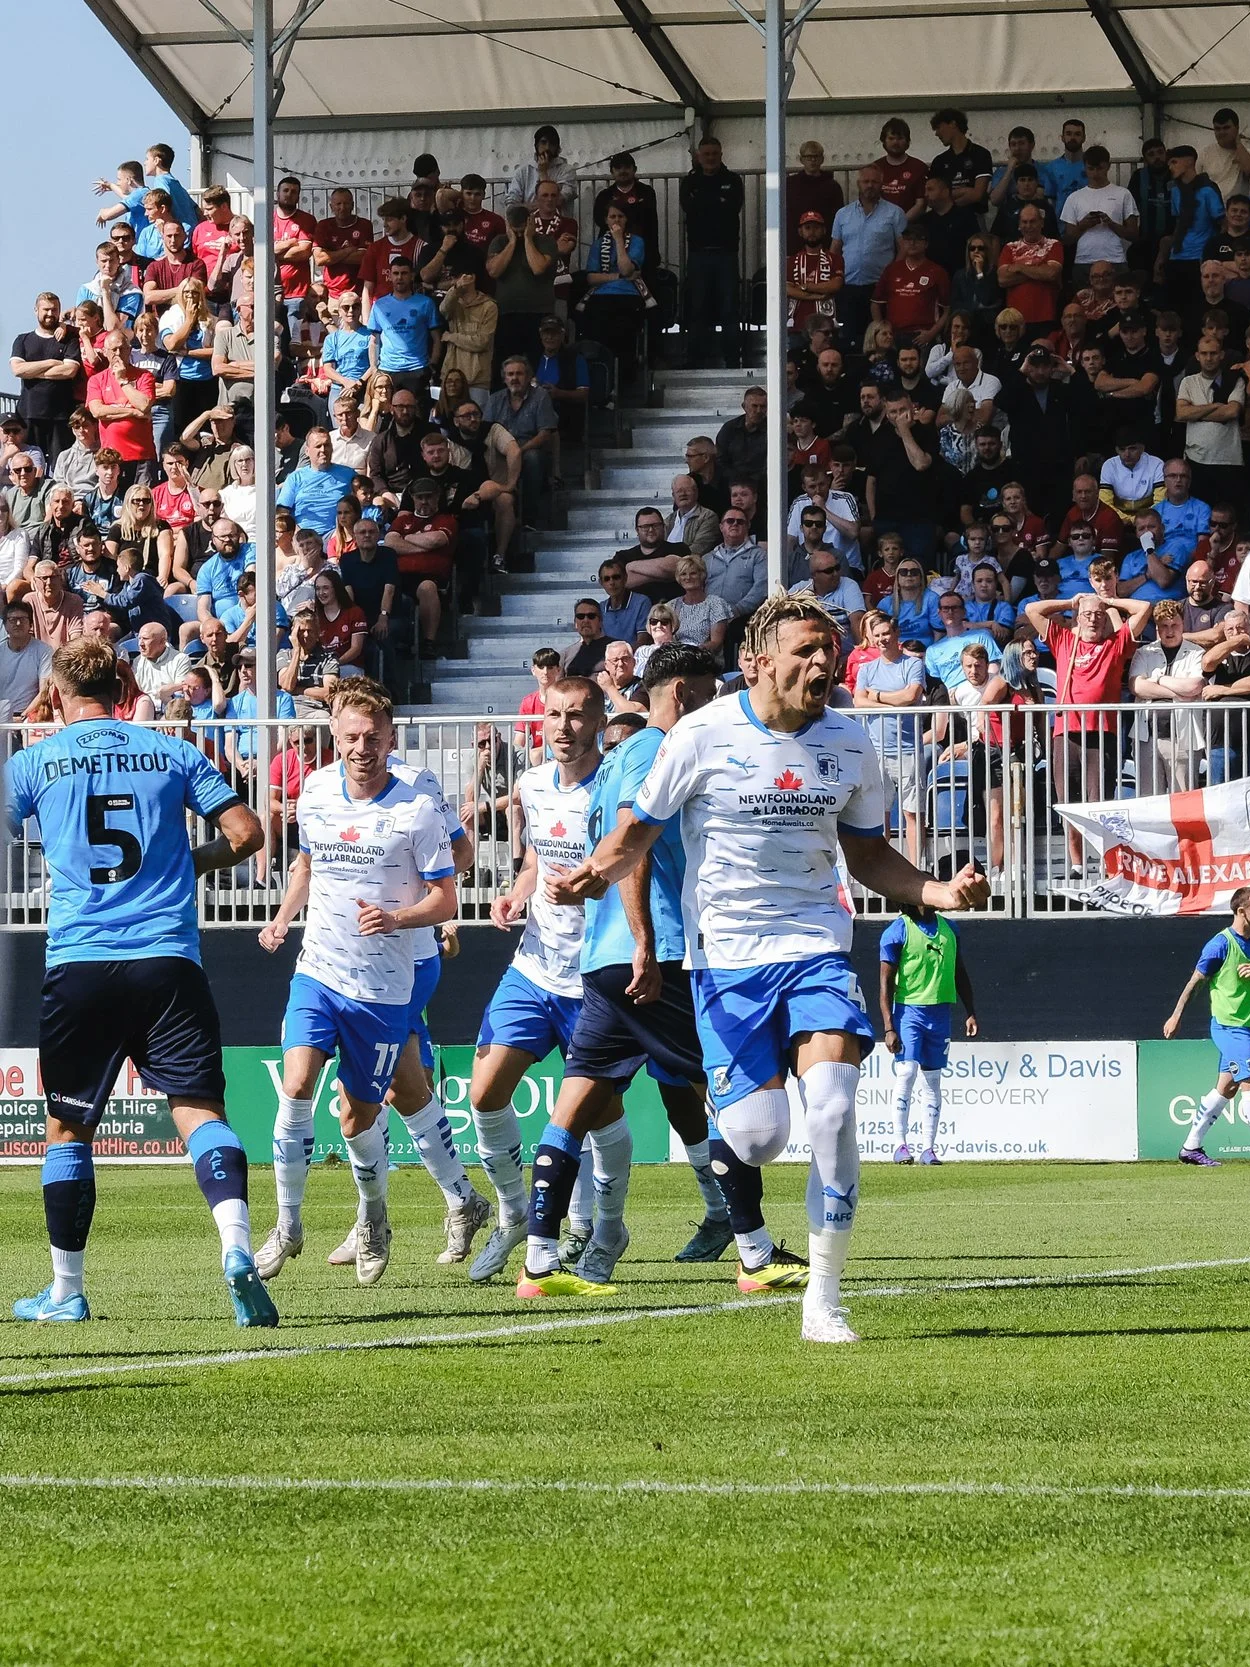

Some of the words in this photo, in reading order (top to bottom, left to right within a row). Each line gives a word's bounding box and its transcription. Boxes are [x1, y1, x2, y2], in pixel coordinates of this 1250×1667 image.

[43, 752, 170, 783] DEMETRIOU
[738, 794, 837, 806] NEWFOUNDLAND
[751, 806, 761, 815] &
[763, 805, 826, 817] LABRADOR
[86, 794, 143, 885] 5
[534, 839, 586, 851] NEWFOUNDLAN
[314, 842, 385, 857] NEWFOUNDLAND
[321, 853, 328, 861] &
[329, 853, 376, 865] LABRADOR
[374, 1042, 400, 1077] 11
[1019, 1054, 1038, 1079] &
[1048, 1054, 1122, 1079] Davis
[940, 1088, 1050, 1105] RECOVERY
[122, 1101, 157, 1115] Hire
[97, 1121, 144, 1135] mbria
[858, 1122, 894, 1136] 1253
[825, 1211, 853, 1222] BAFC
